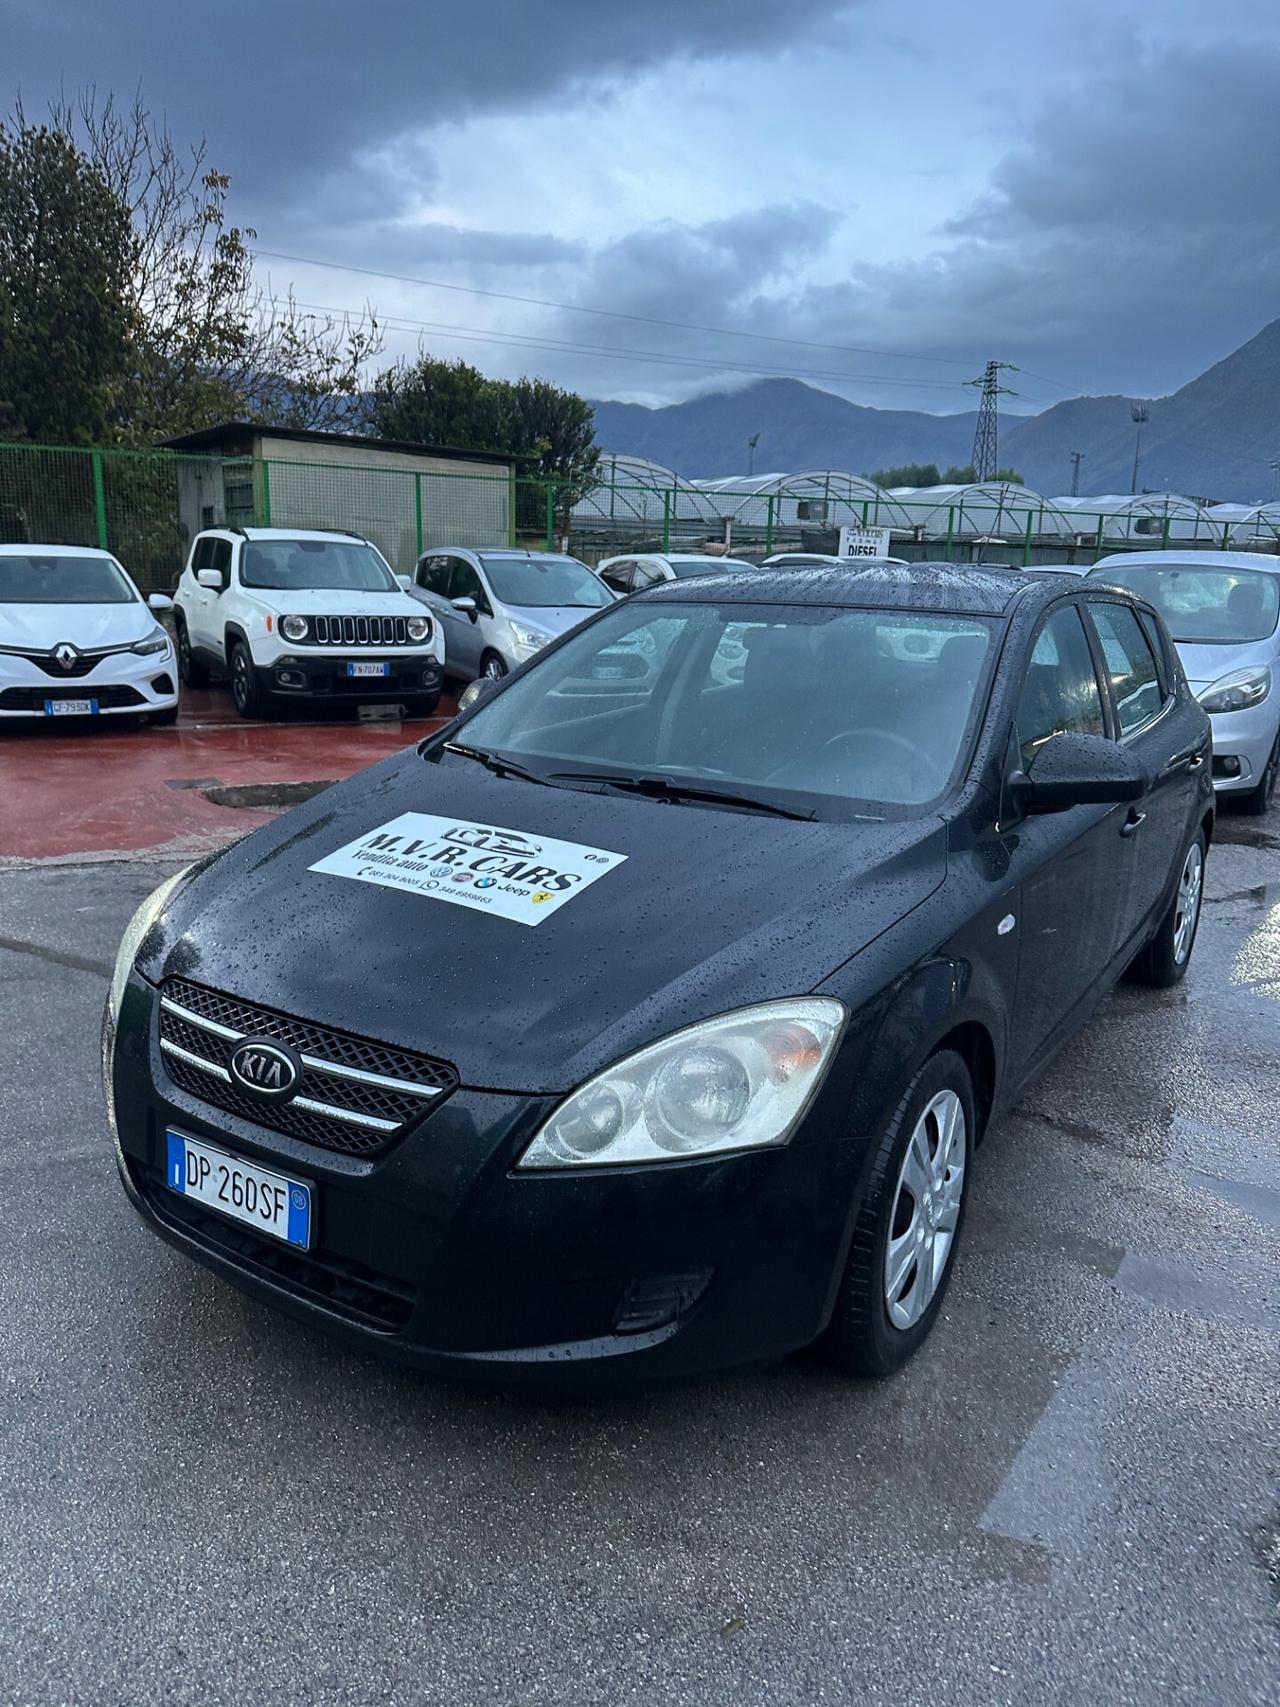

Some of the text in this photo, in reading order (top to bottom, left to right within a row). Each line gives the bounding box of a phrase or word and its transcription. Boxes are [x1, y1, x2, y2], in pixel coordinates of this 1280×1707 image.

[848, 545, 877, 557] DIESEL
[352, 849, 399, 867] Vendita
[396, 860, 429, 871] auto
[497, 879, 531, 897] Jeep
[360, 833, 582, 891] M.V.R. CARS
[241, 1051, 281, 1088] KIA
[187, 1150, 211, 1190] DP
[218, 1165, 287, 1225] 260SF
